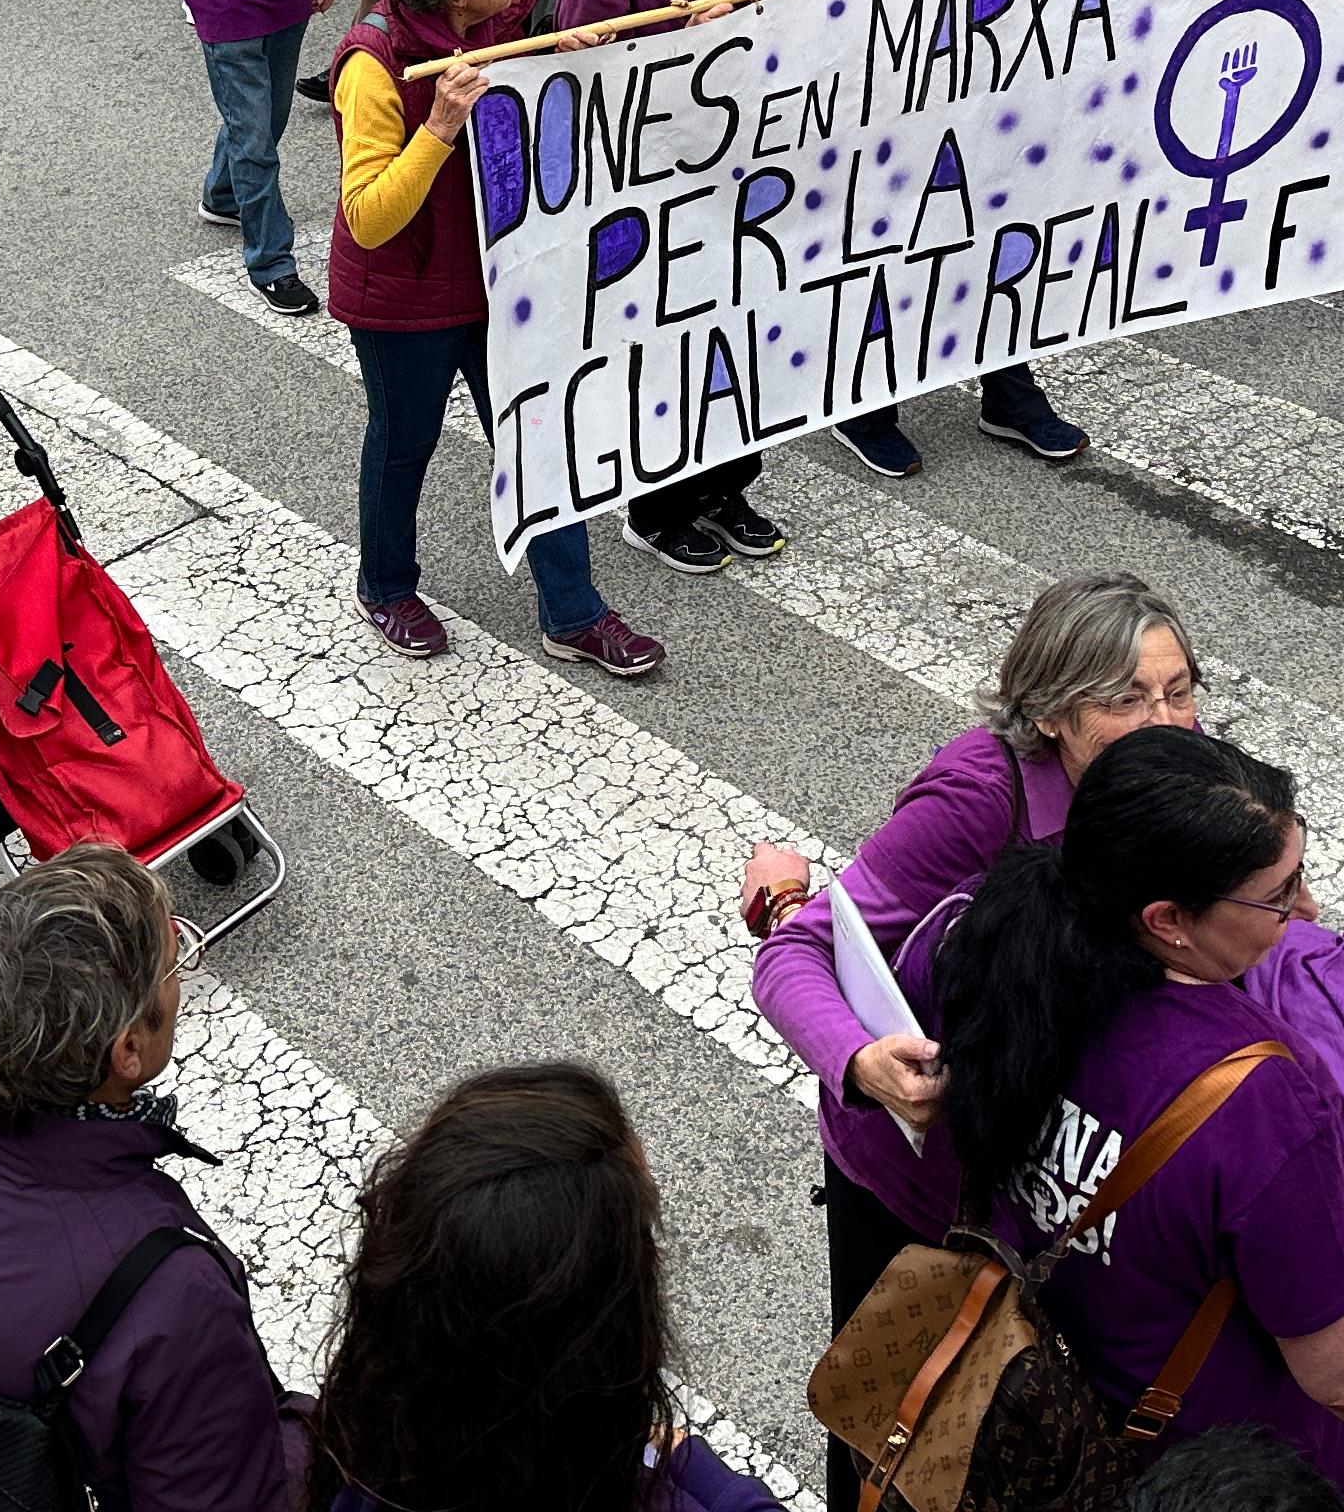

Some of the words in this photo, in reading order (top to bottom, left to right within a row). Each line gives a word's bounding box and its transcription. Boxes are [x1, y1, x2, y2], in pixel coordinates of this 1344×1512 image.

[472, 36, 753, 250] DONES
[752, 71, 840, 159] EN
[583, 166, 795, 349] PER
[843, 128, 975, 264] LA
[497, 240, 976, 555] IGUALTAT
[975, 198, 1189, 364] REAL
